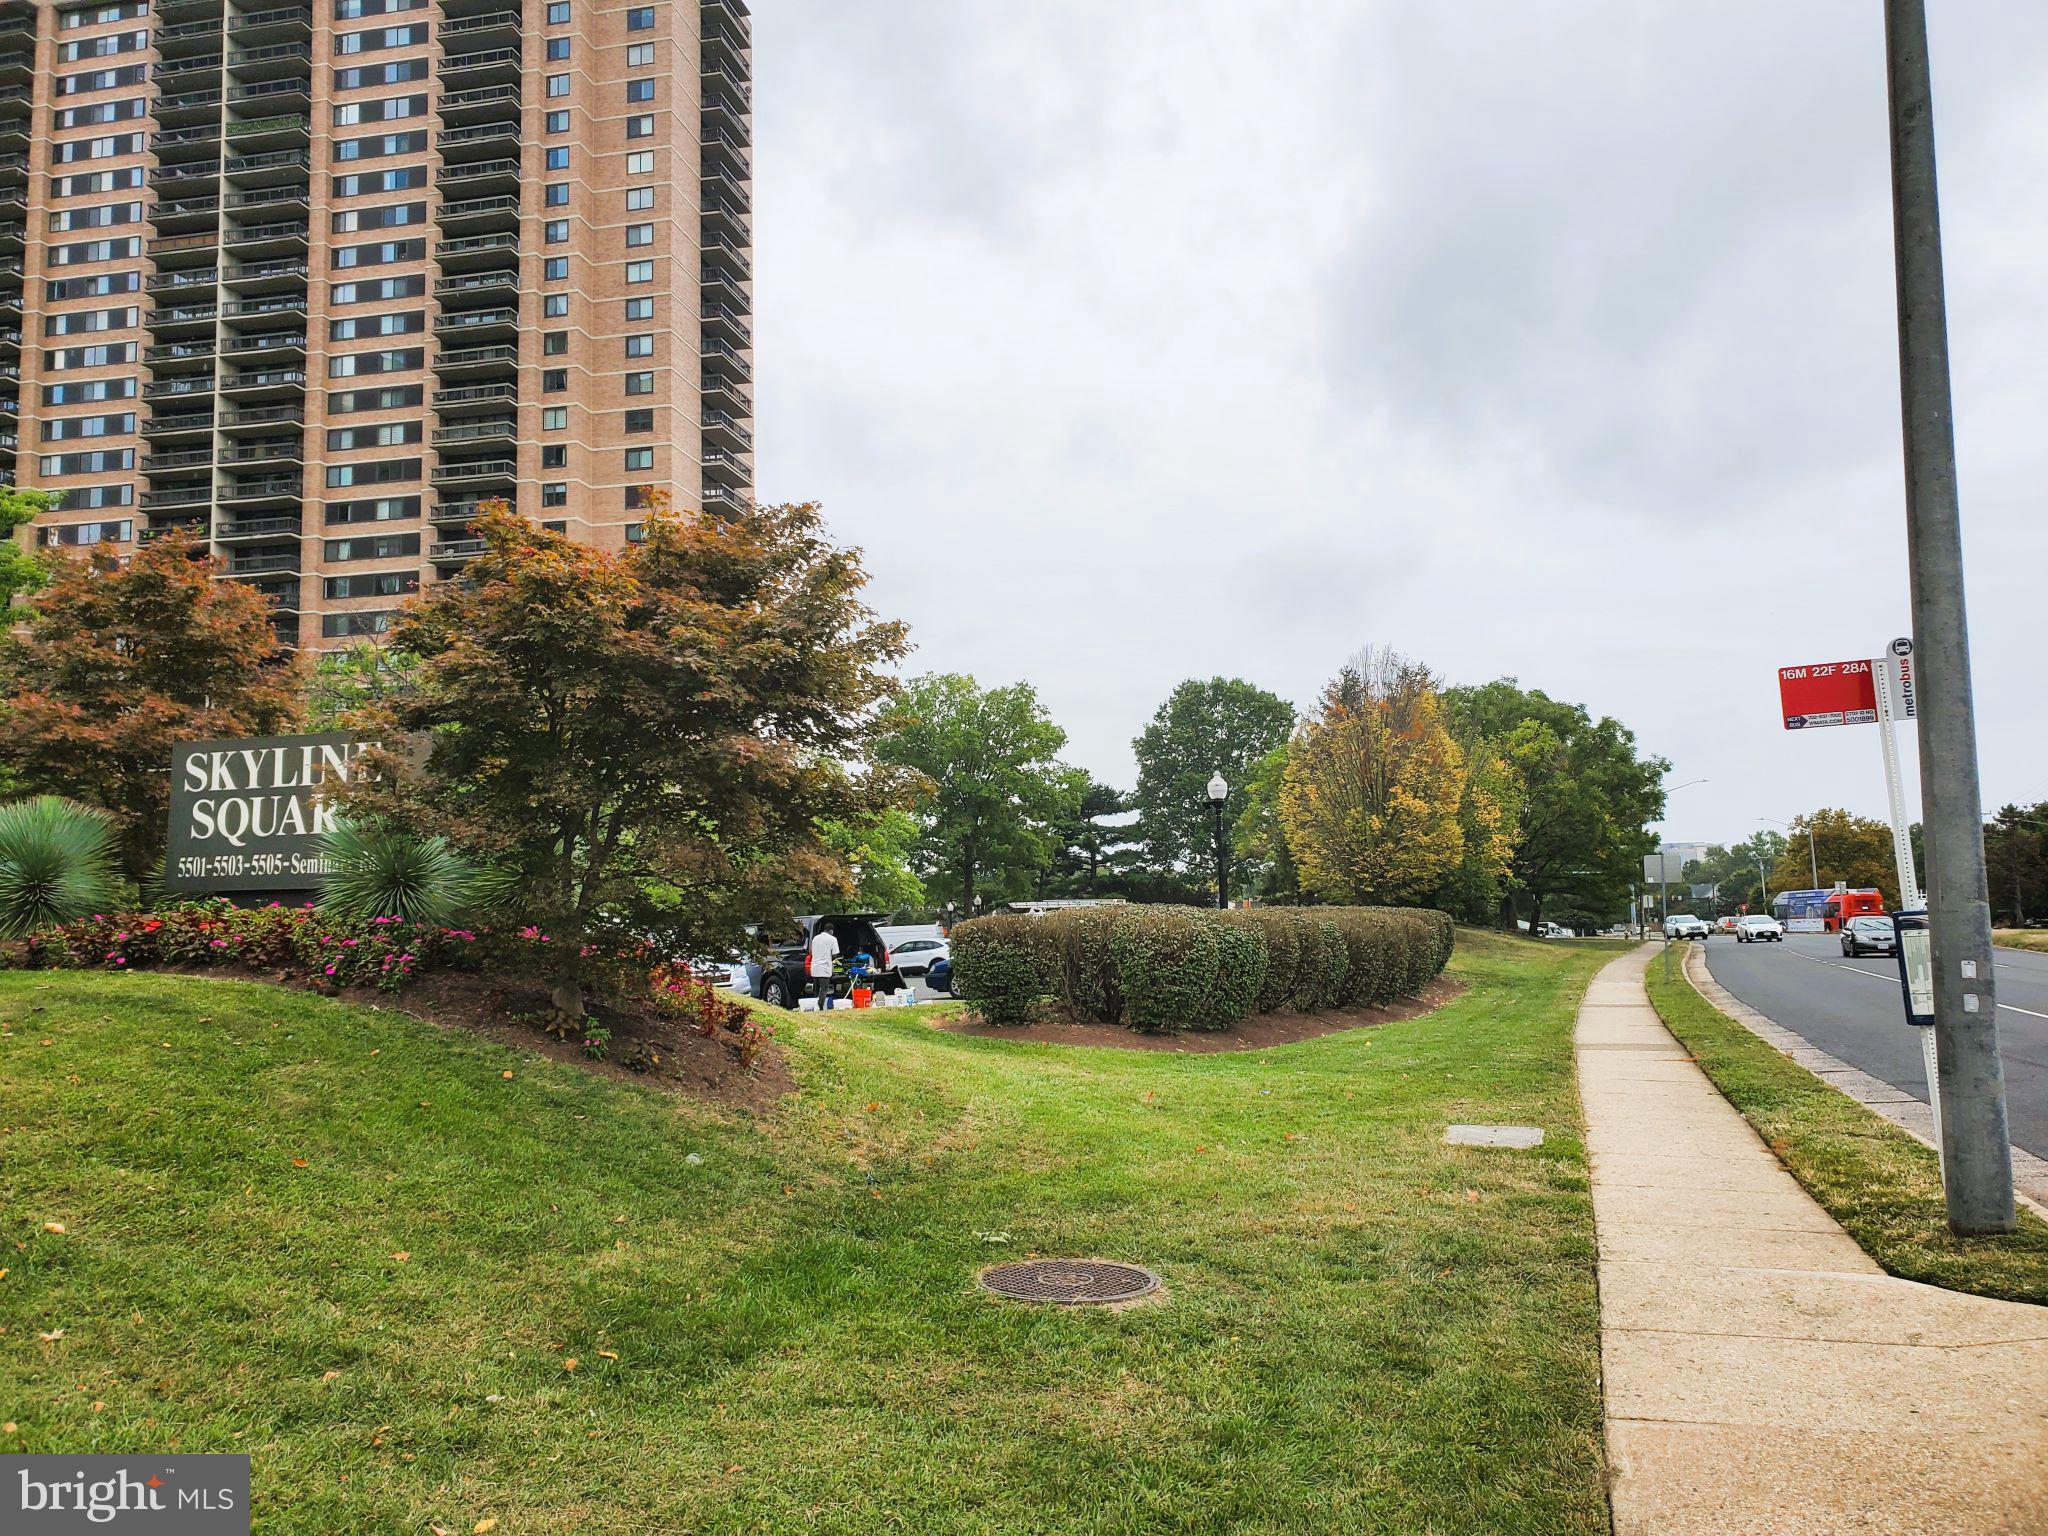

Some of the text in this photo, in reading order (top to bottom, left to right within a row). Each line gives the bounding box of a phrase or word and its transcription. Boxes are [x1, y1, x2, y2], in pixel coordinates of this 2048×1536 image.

[1781, 662, 1868, 680] 16M 22F 28A
[1900, 658, 1915, 716] metrobus
[184, 741, 382, 793] SKYLINE
[190, 793, 339, 847] SQUAR
[177, 853, 344, 878] 5501-5503-5505-Semin
